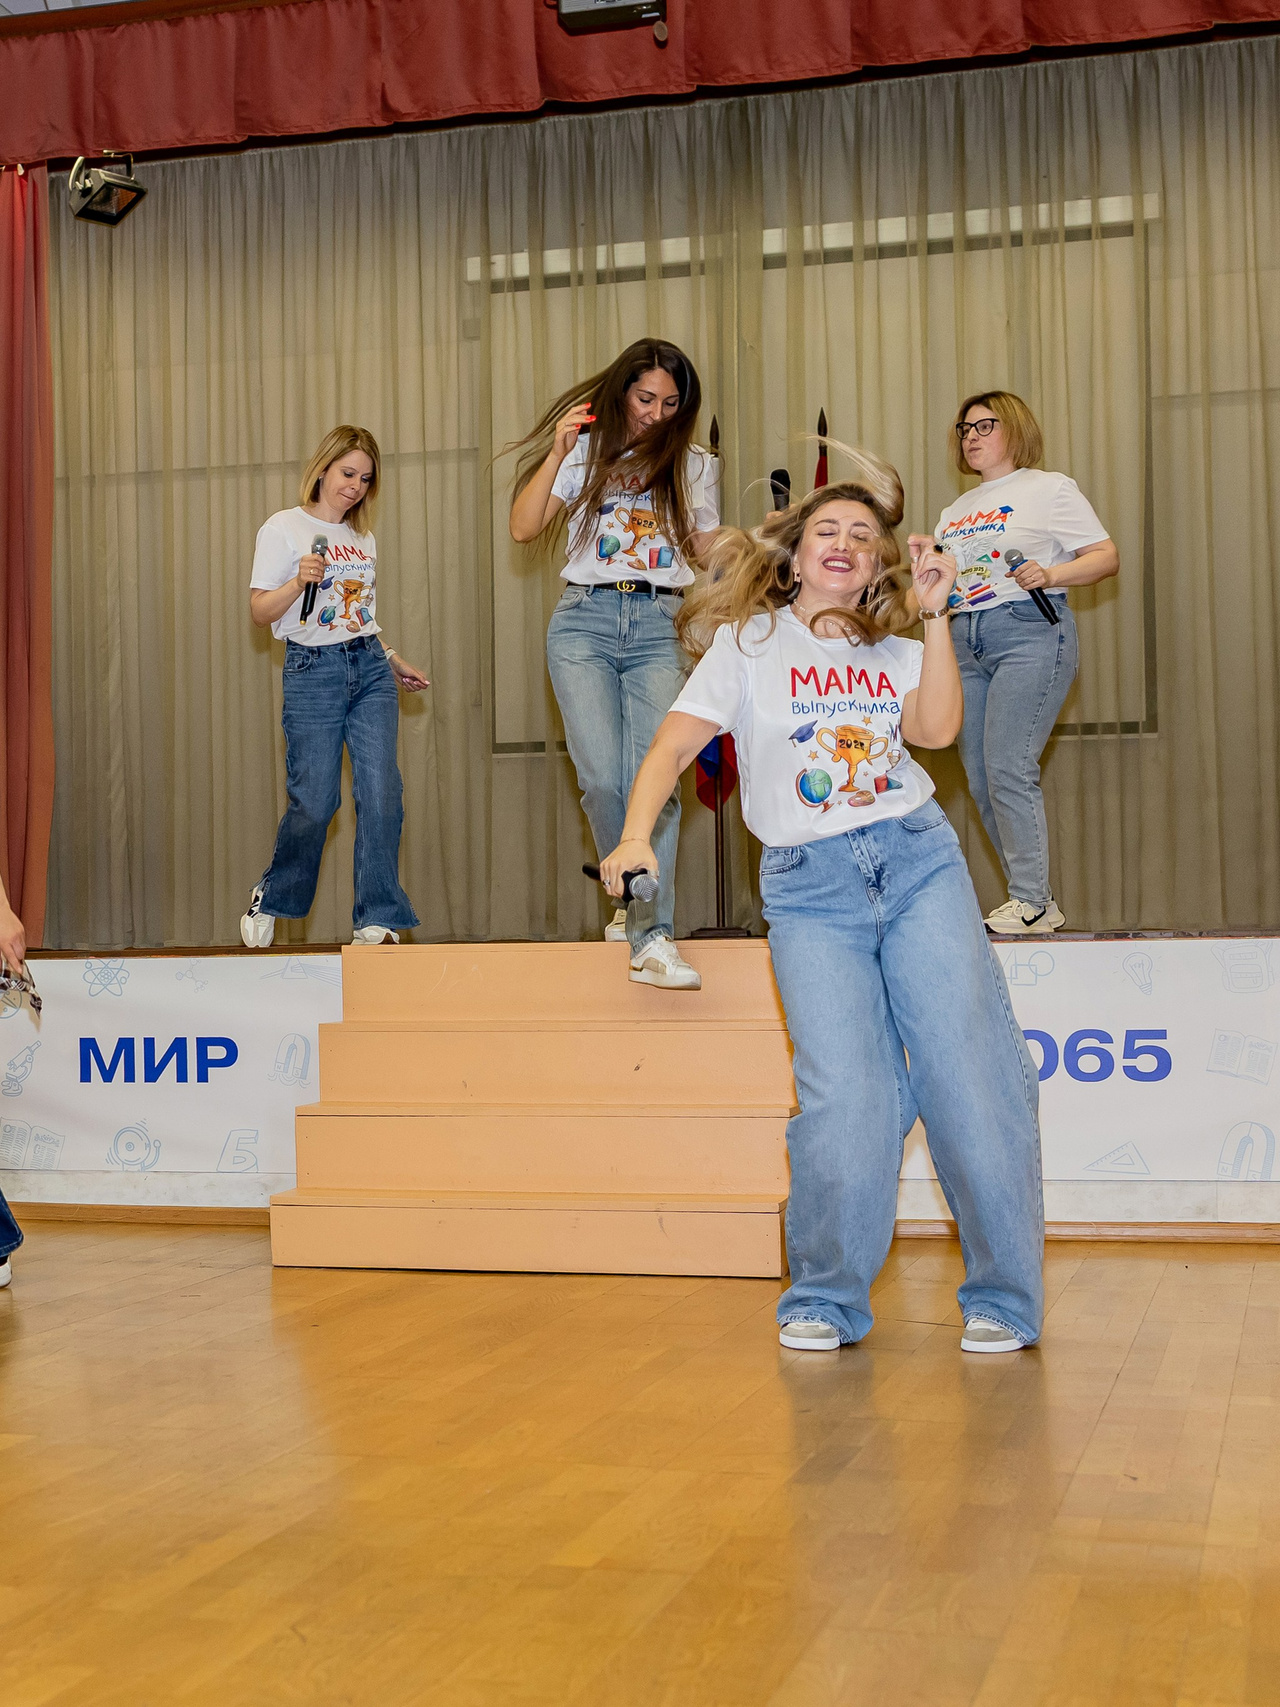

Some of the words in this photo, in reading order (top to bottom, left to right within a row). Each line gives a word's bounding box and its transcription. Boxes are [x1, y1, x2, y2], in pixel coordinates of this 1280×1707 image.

[942, 508, 1009, 534] МАМА
[790, 664, 897, 698] МАМА
[78, 1036, 239, 1084] МИР
